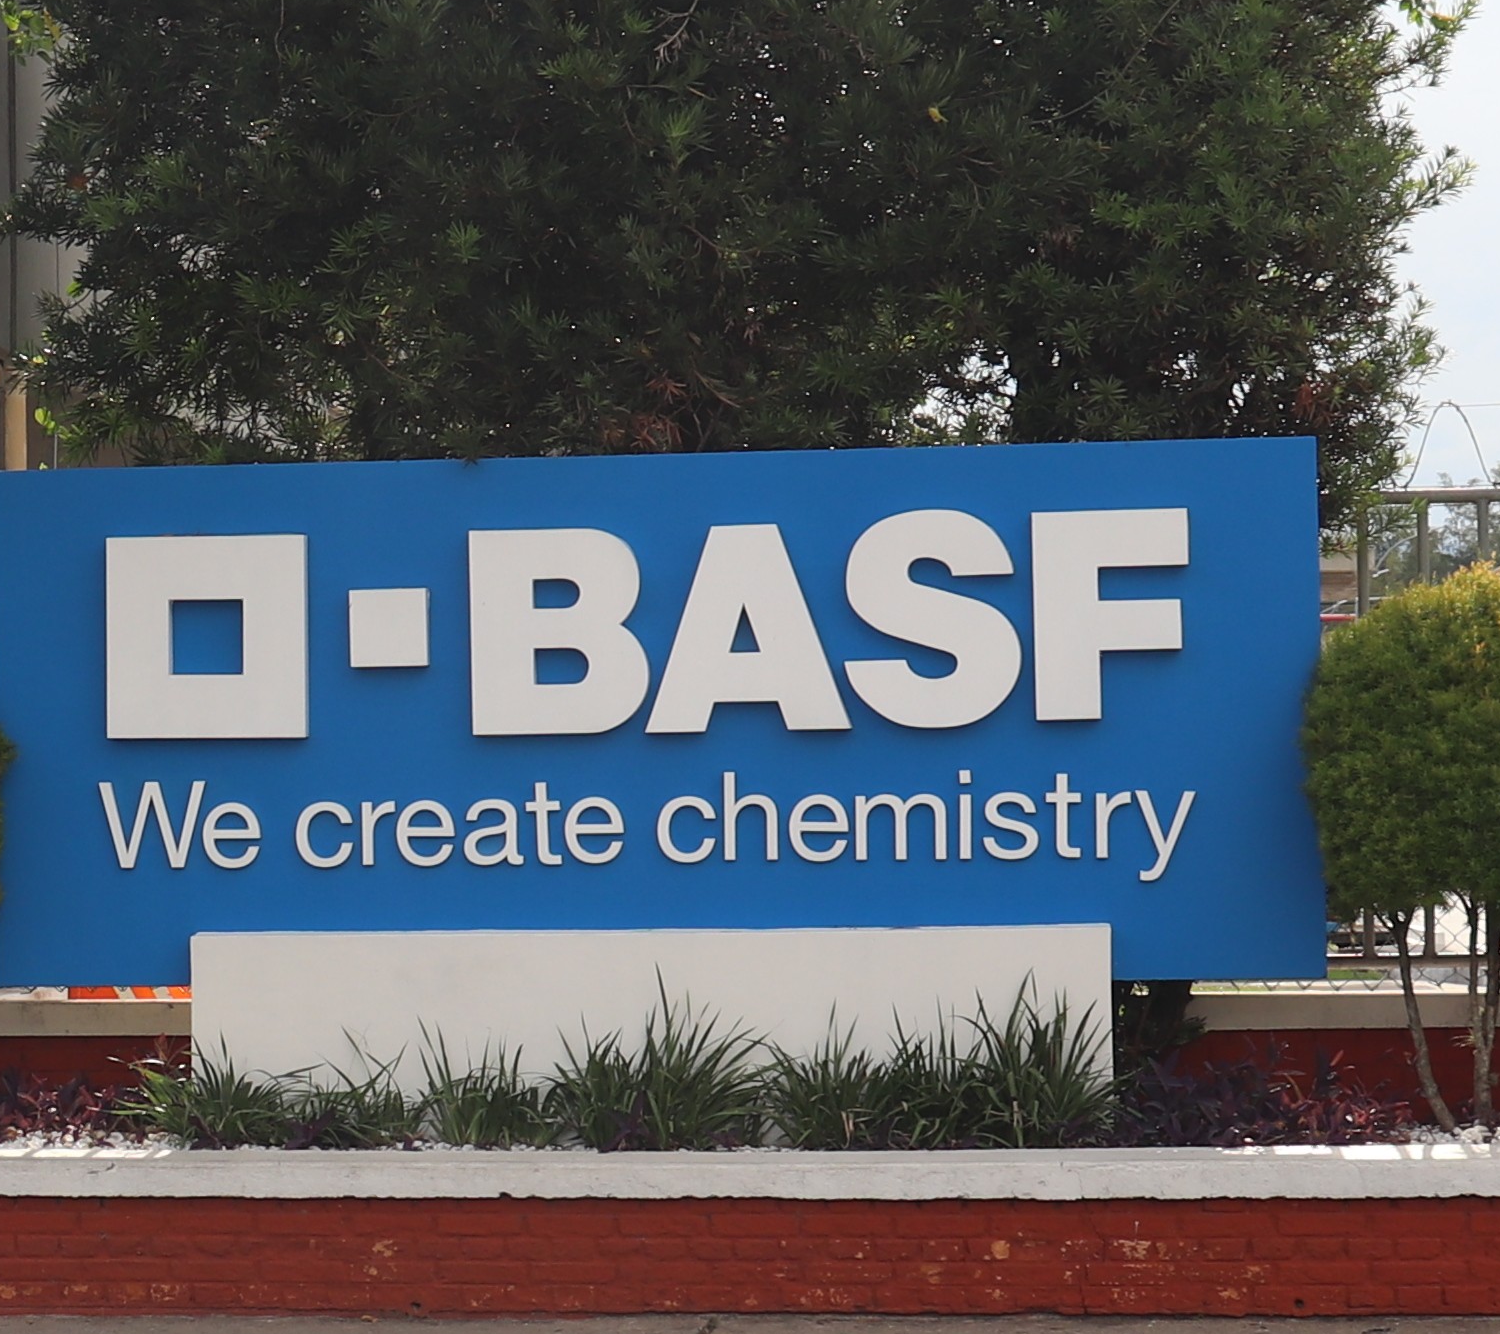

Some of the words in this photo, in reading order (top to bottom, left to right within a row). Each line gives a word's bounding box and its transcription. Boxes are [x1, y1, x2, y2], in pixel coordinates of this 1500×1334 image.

[467, 507, 1190, 736] BASF
[98, 779, 263, 870] We
[294, 780, 626, 869] create
[656, 769, 1197, 882] chemistry
